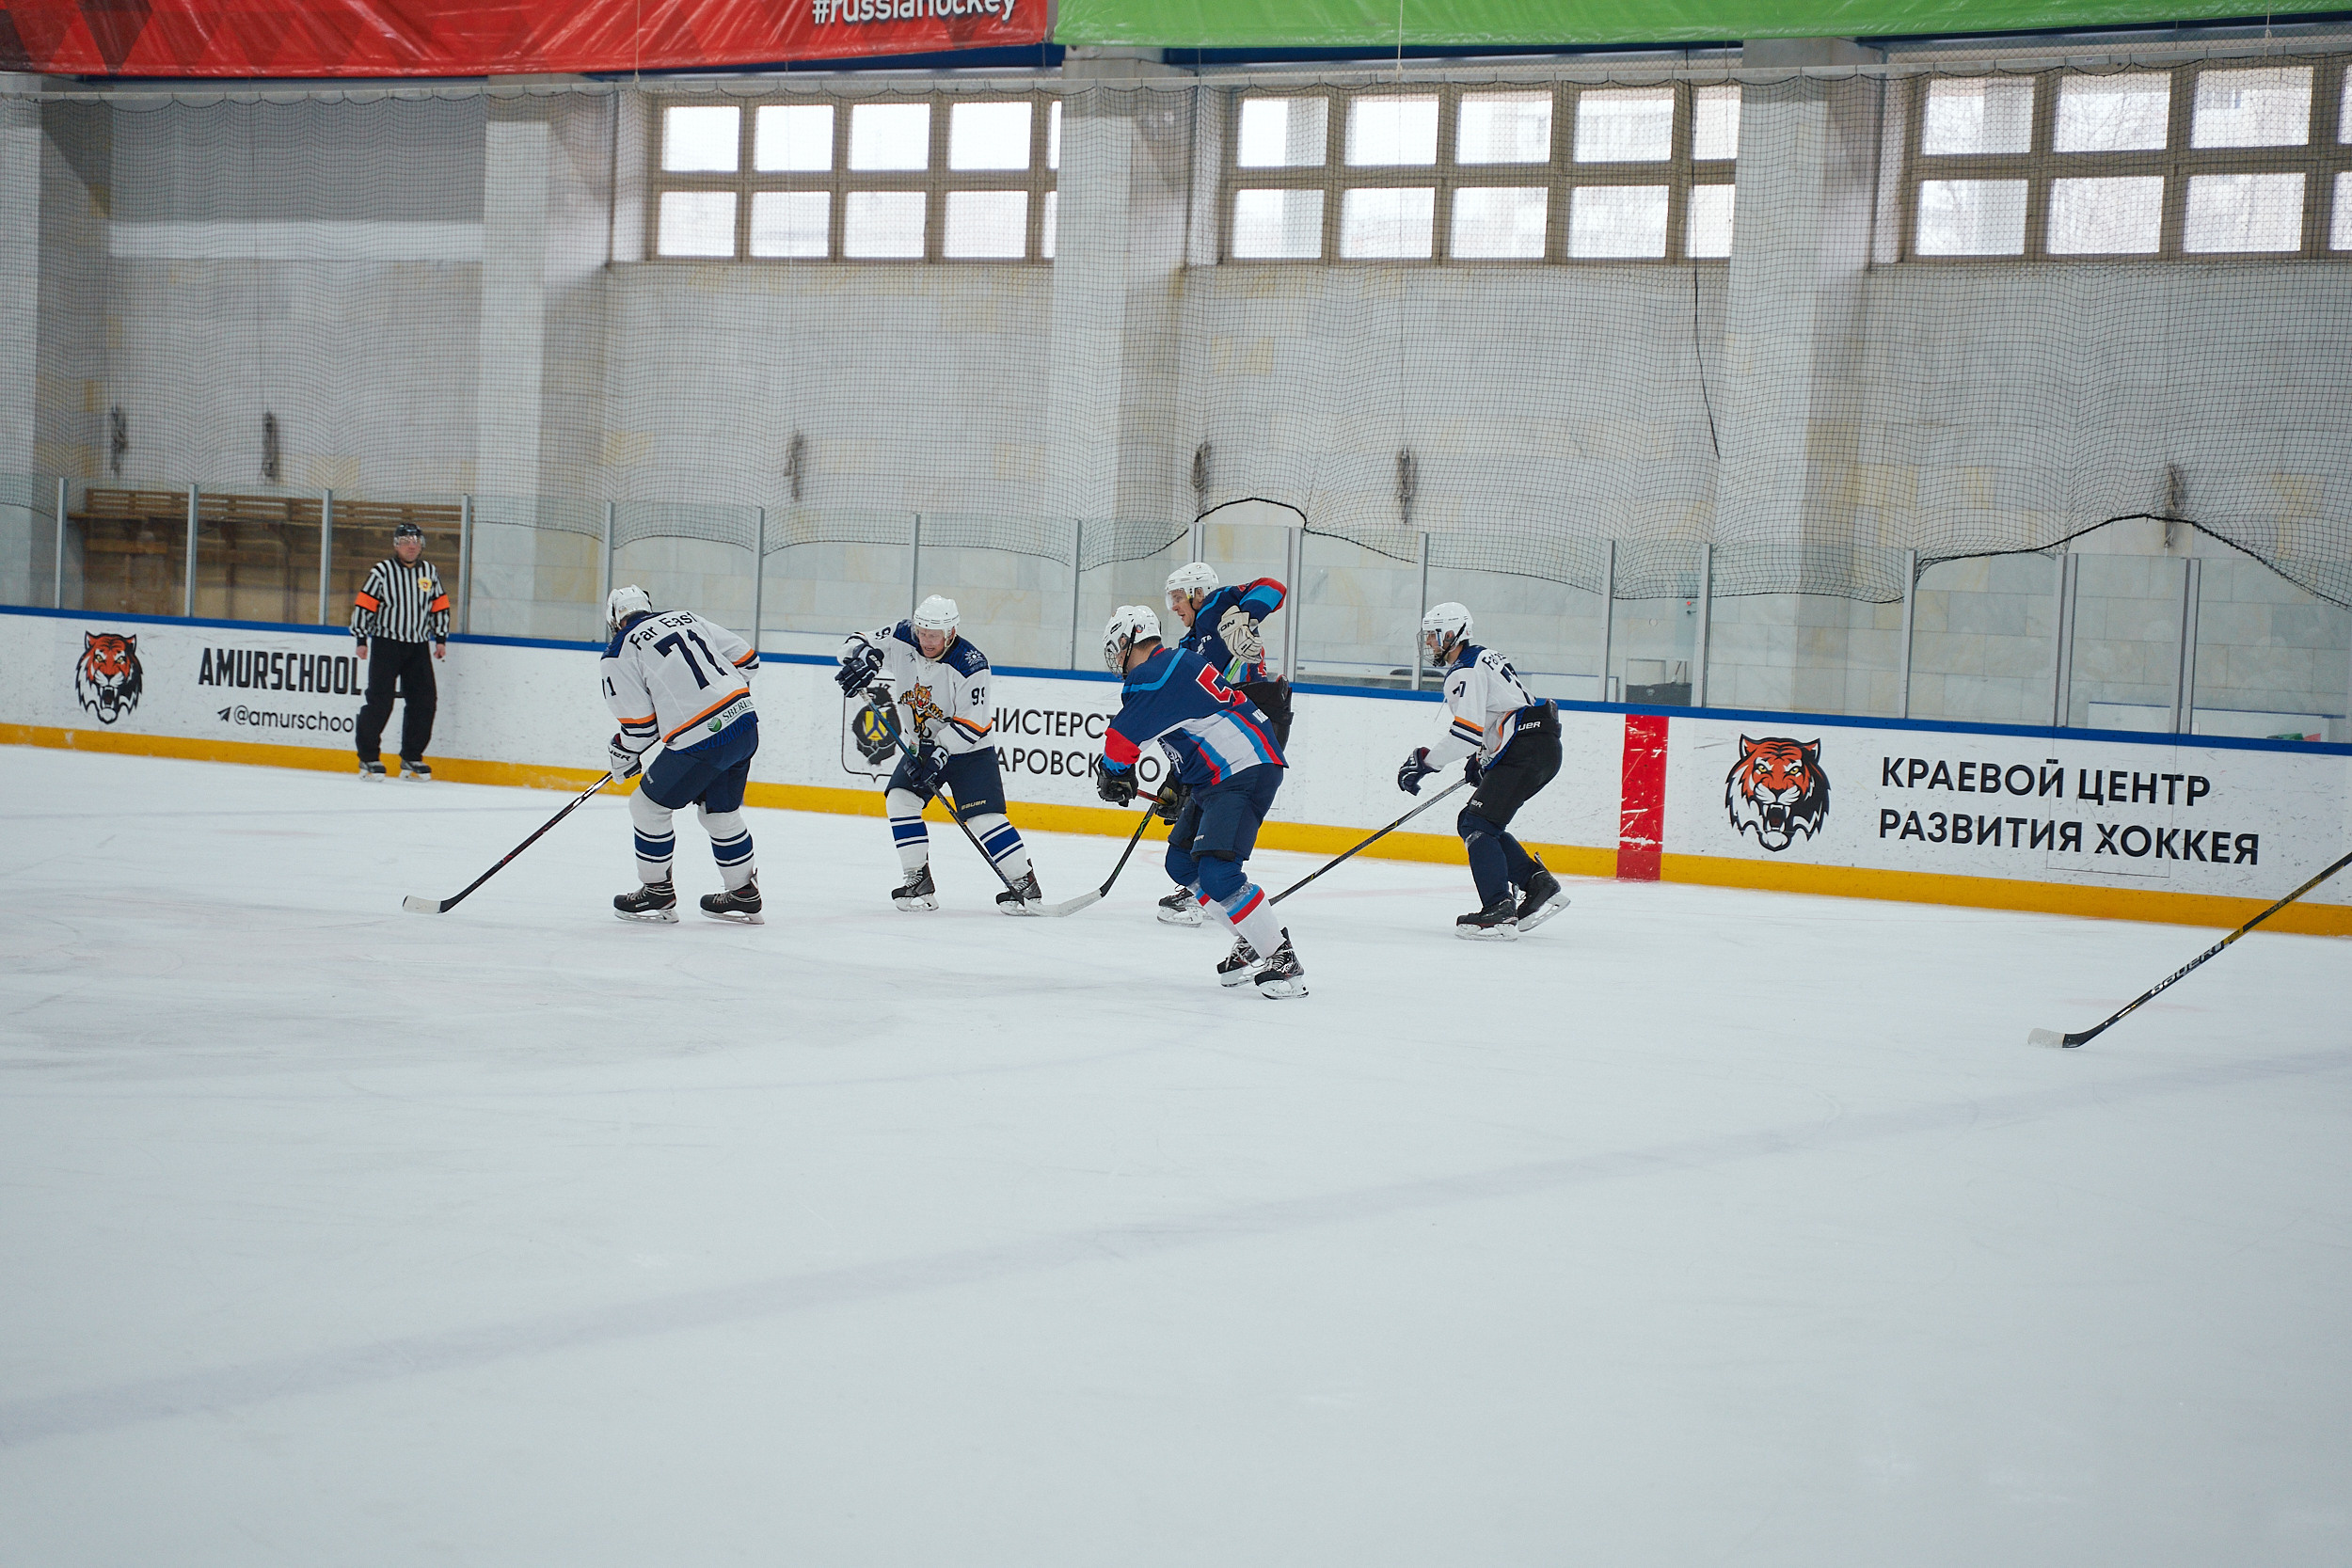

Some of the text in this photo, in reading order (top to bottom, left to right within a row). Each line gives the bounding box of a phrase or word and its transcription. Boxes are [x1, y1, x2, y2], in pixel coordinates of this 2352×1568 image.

[628, 626, 659, 651] Far
[653, 629, 728, 689] 71
[198, 647, 362, 696] AMURSCHOOL
[991, 706, 1117, 739] НИСТЕРС
[1518, 721, 1542, 732] UER
[1882, 756, 2211, 807] КРАЕВОЙ ЦЕНТР
[1879, 808, 2260, 866] РАЗВИТИЯ ХОККЕЯ
